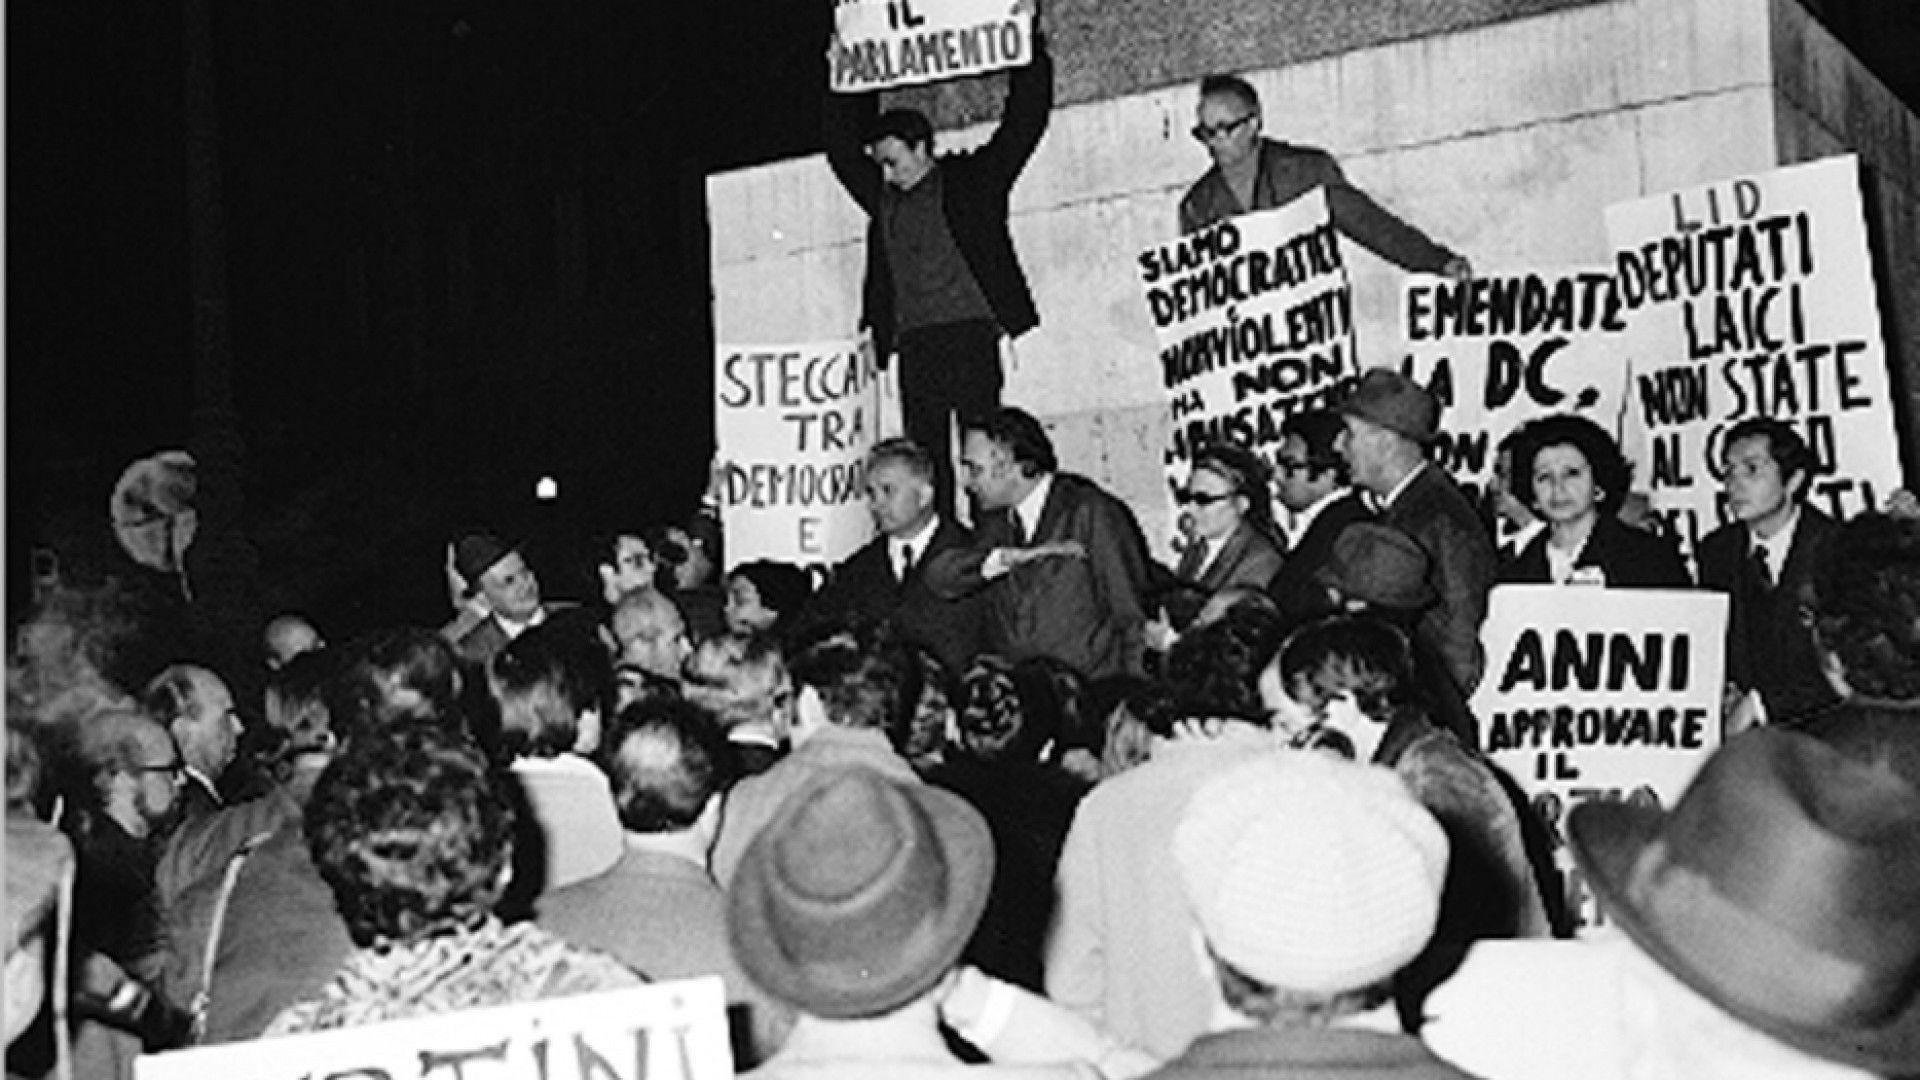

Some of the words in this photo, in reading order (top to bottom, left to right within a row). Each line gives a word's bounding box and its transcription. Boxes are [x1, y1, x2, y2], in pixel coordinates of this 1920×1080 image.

[889, 0, 924, 30] IL
[836, 21, 1021, 86] PARLAMENTO
[1672, 180, 1761, 232] LID
[1138, 223, 1241, 283] SIAMO
[1617, 210, 1813, 309] DEPUTATI
[1408, 272, 1628, 340] EMENDATE
[1684, 281, 1806, 360] LAICI
[1233, 343, 1343, 403] NON
[1636, 361, 1709, 429] NON
[1721, 340, 1873, 421] STATE
[1653, 432, 1693, 490] AL
[799, 517, 822, 553] E
[1498, 629, 1689, 693] ANNI
[1489, 706, 1708, 749] APPROVARE
[1536, 752, 1581, 780] IL
